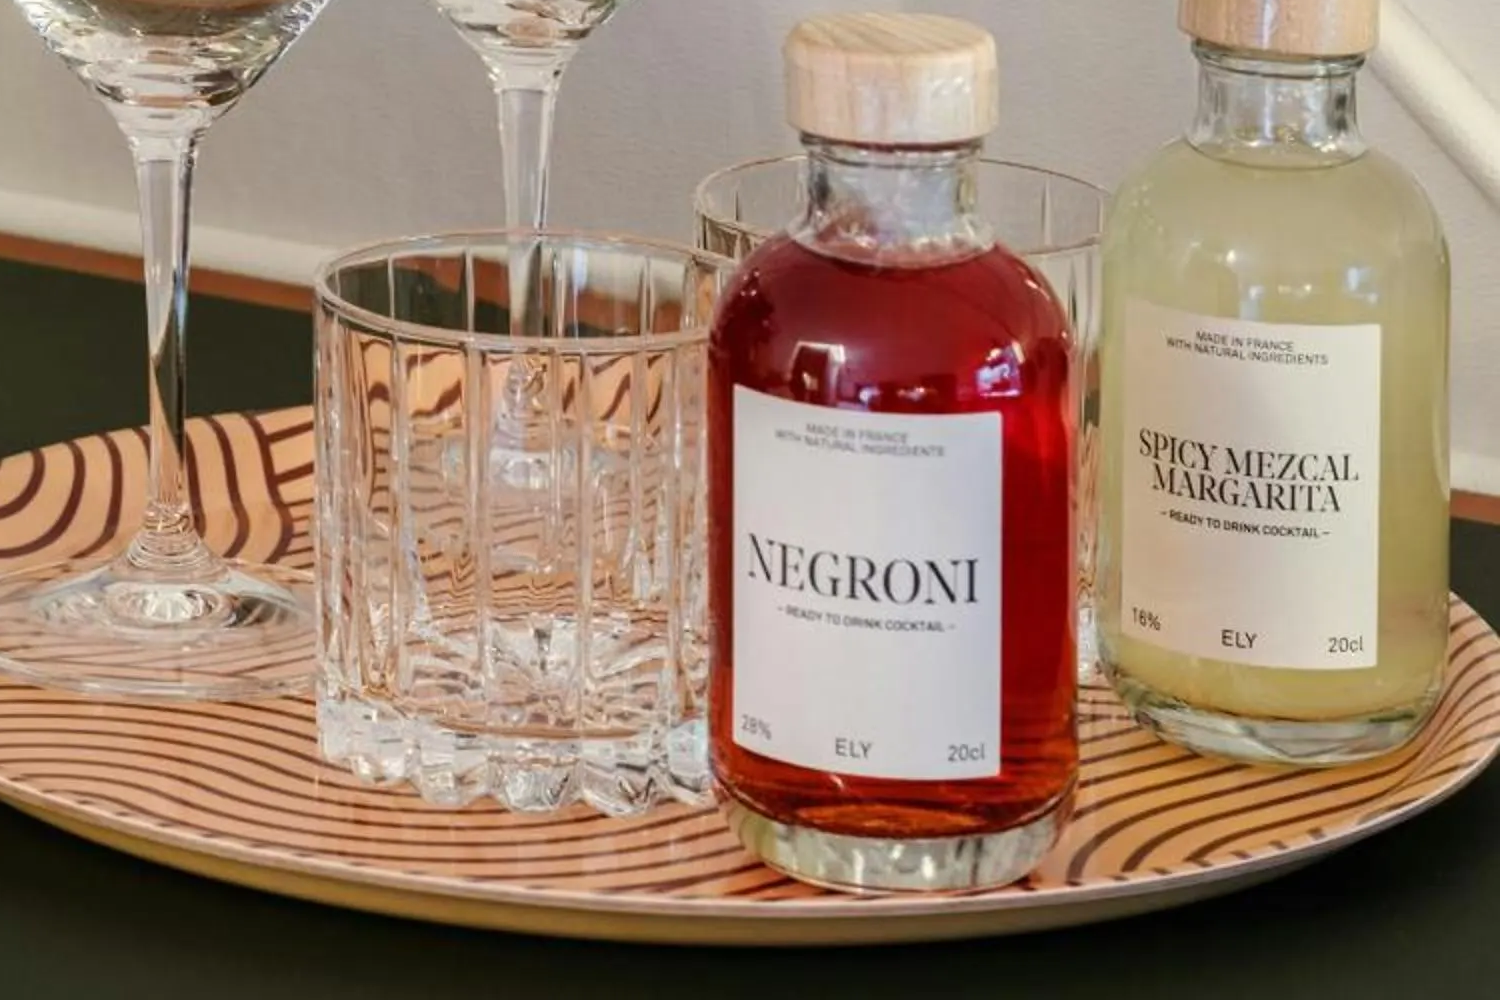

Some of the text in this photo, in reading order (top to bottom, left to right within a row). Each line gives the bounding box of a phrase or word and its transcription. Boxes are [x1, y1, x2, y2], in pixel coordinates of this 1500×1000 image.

[1166, 337, 1329, 365] WITH NATURAL INGREDIENTS
[1196, 331, 1295, 352] MADE IN FRANCE
[805, 423, 838, 437] MADE
[858, 429, 908, 443] FRANCE
[804, 435, 856, 452] NATURAL
[860, 444, 946, 456] INGREDIENTS
[1139, 427, 1359, 481] SPICY MEZCAL
[1152, 463, 1340, 512] MARGARITA
[1169, 509, 1319, 538] READY TO DRINK COCKTAIL
[748, 532, 979, 605] NEGRONI
[785, 605, 945, 632] READY TO DRINK COCKTAIL
[1132, 607, 1161, 631] 16%
[1221, 629, 1257, 649] ELY
[1329, 636, 1363, 653] 20cl
[741, 714, 771, 740] 28%
[835, 737, 872, 758] ELY
[948, 743, 985, 762] 20cl
